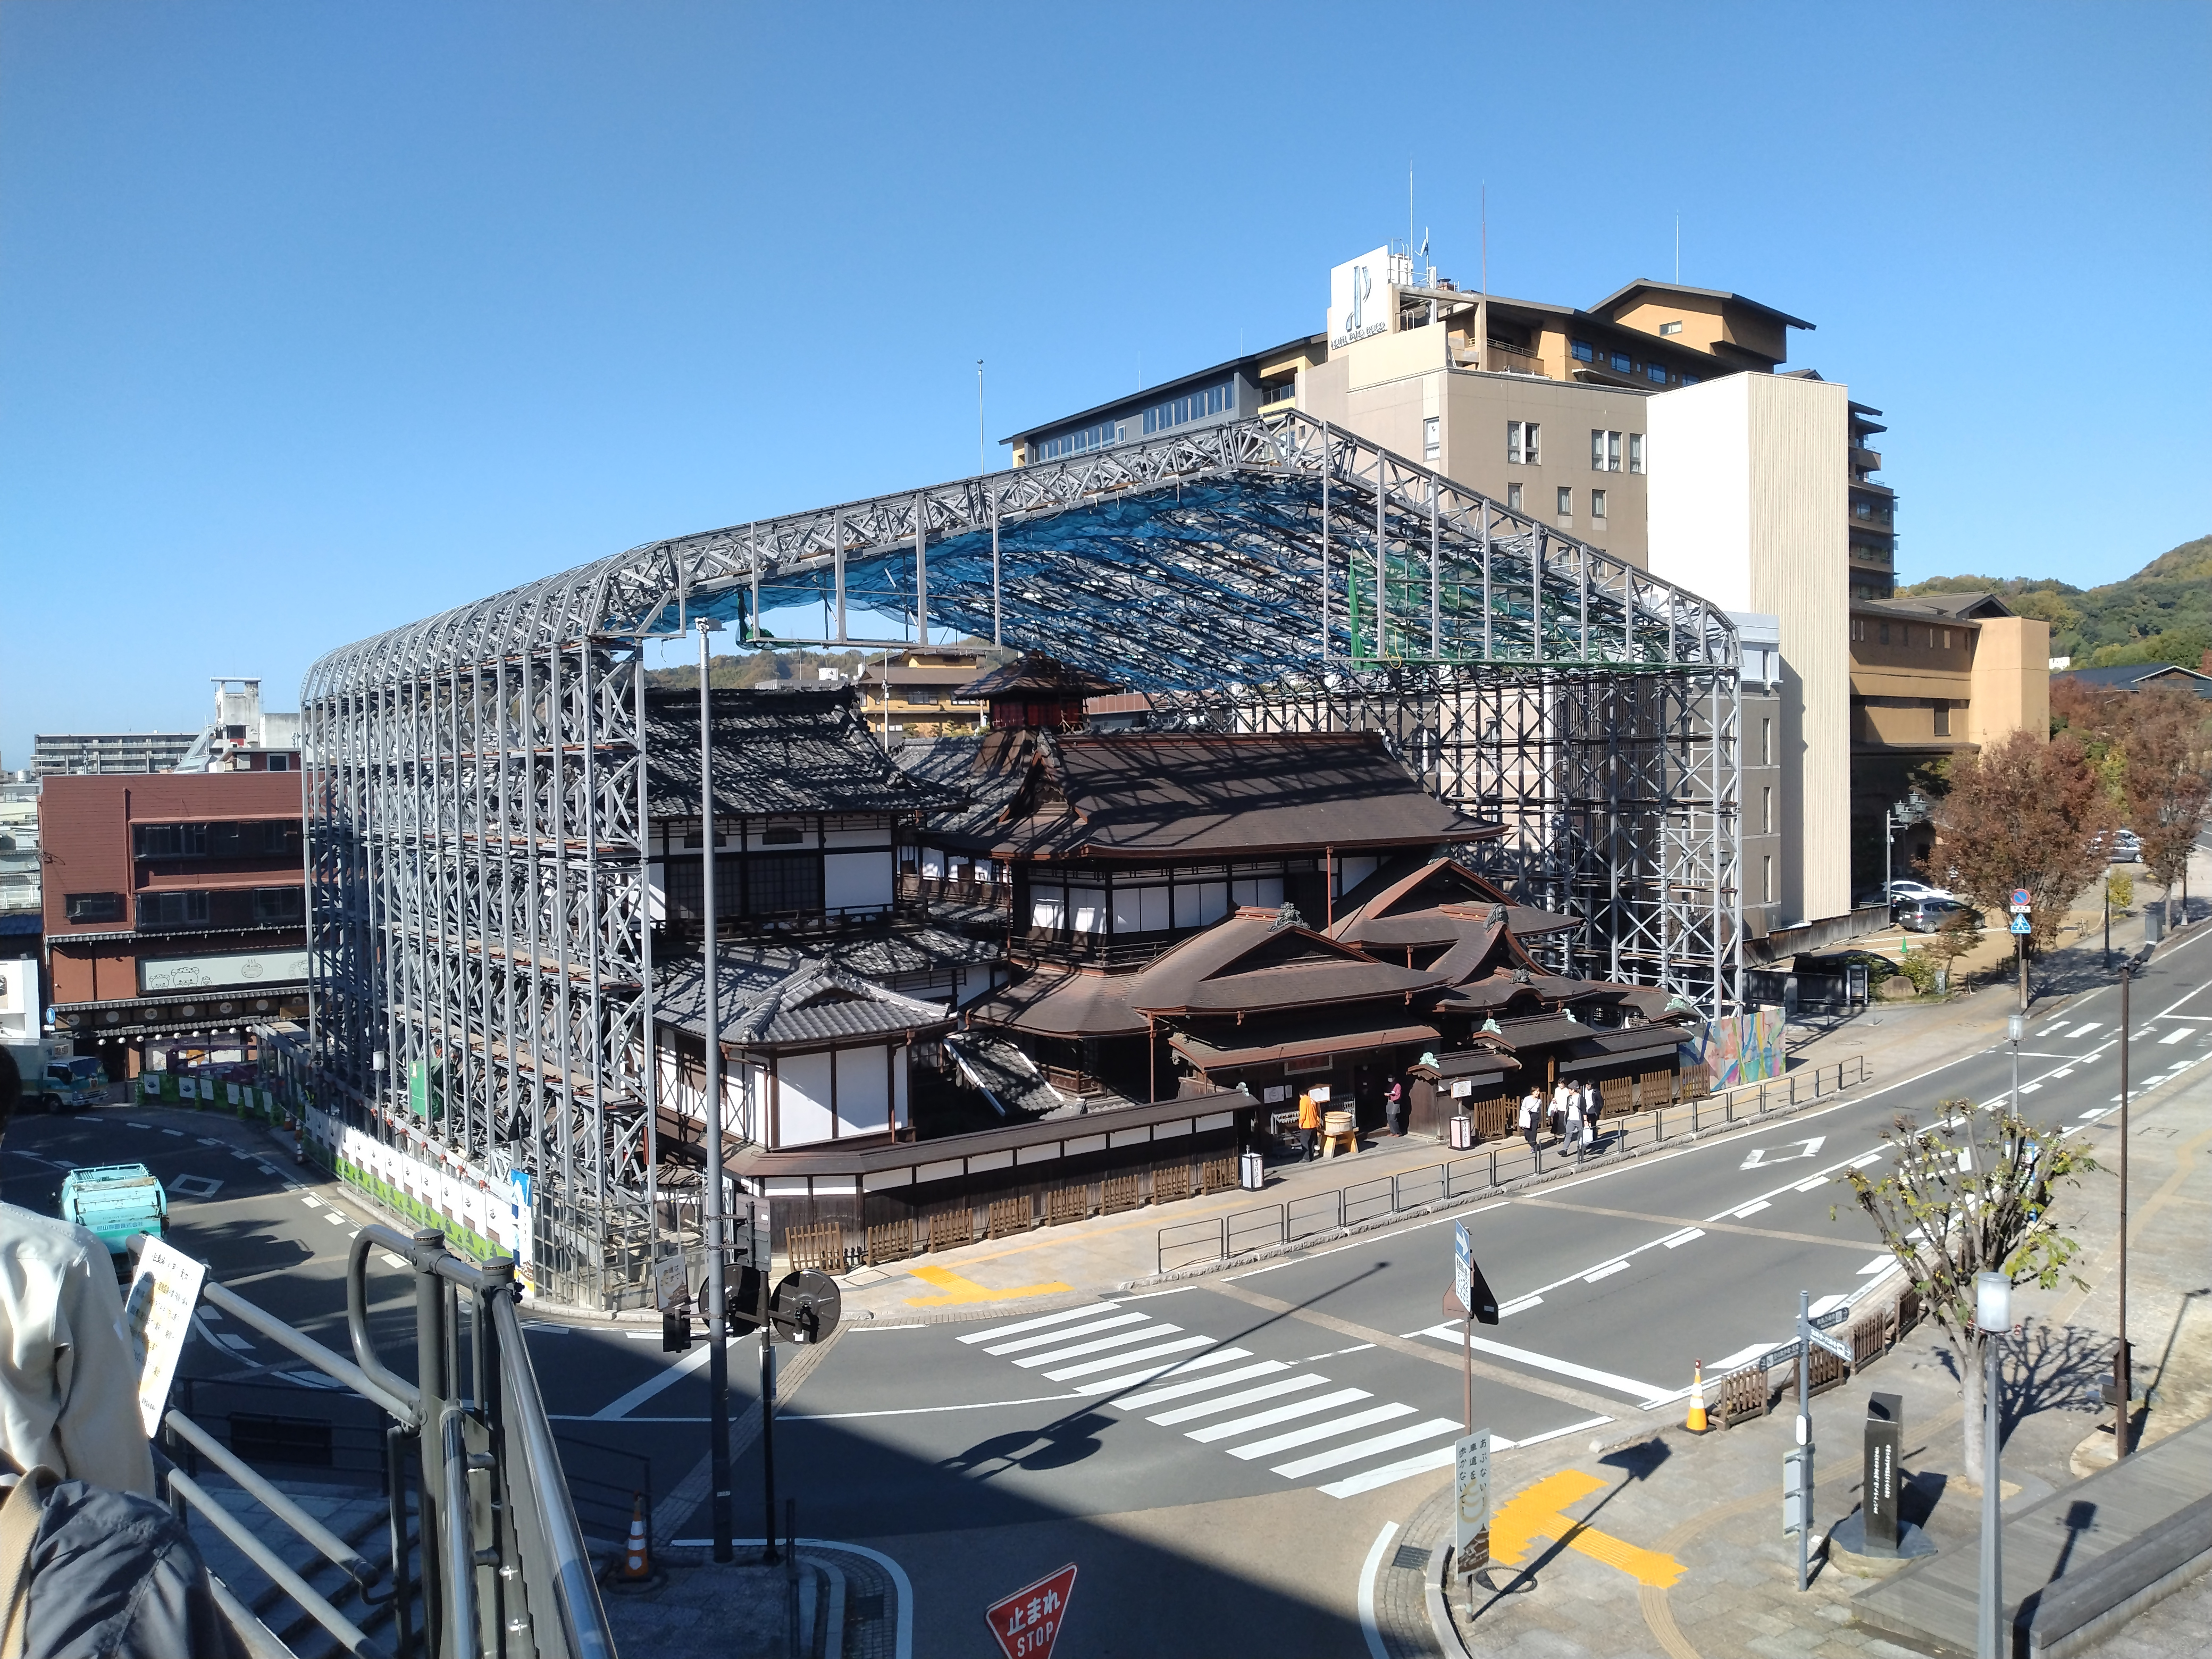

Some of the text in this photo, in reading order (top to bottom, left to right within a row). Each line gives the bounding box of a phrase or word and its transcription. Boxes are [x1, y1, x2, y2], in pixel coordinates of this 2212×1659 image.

[1007, 1589, 1060, 1637] 止まれ
[1017, 1621, 1054, 1657] STOP
